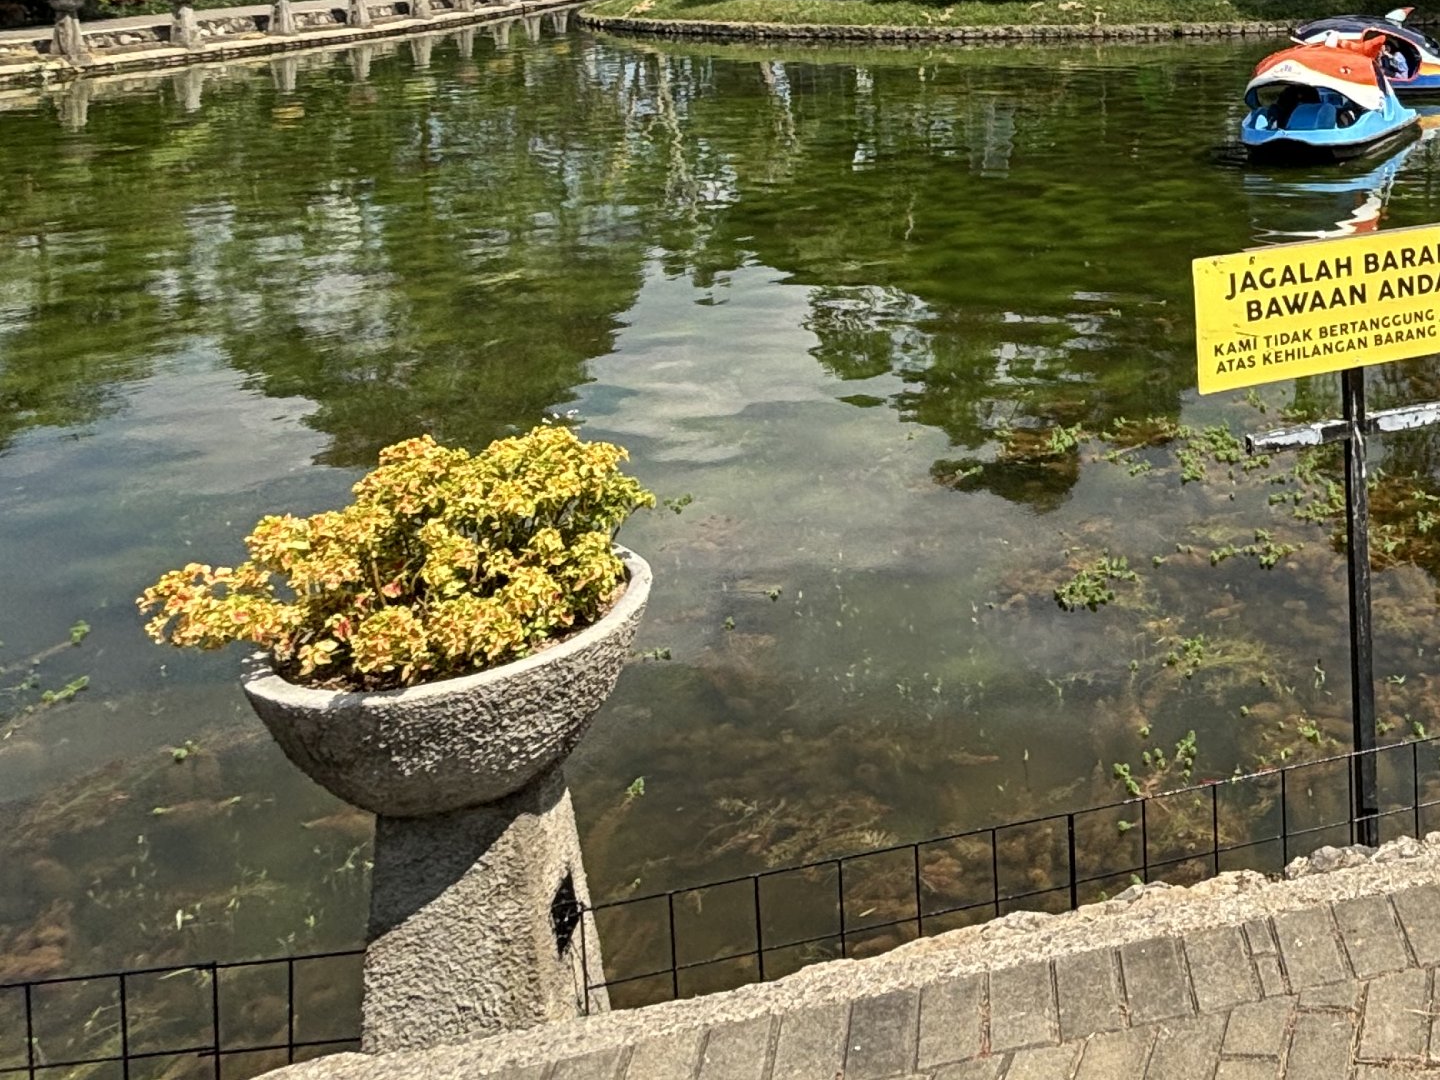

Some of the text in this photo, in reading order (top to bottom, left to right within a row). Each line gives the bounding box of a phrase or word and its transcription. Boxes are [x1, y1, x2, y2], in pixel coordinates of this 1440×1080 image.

[1225, 256, 1351, 300] JAGALAH
[1246, 283, 1366, 322] BAWAAN
[1214, 336, 1257, 357] KAMI
[1263, 328, 1312, 348] TIDAK
[1318, 308, 1435, 339] BERTANGGUNG
[1216, 355, 1256, 374] ATAS
[1262, 337, 1368, 366] KEHILANGAN
[1374, 325, 1437, 347] BARANG
